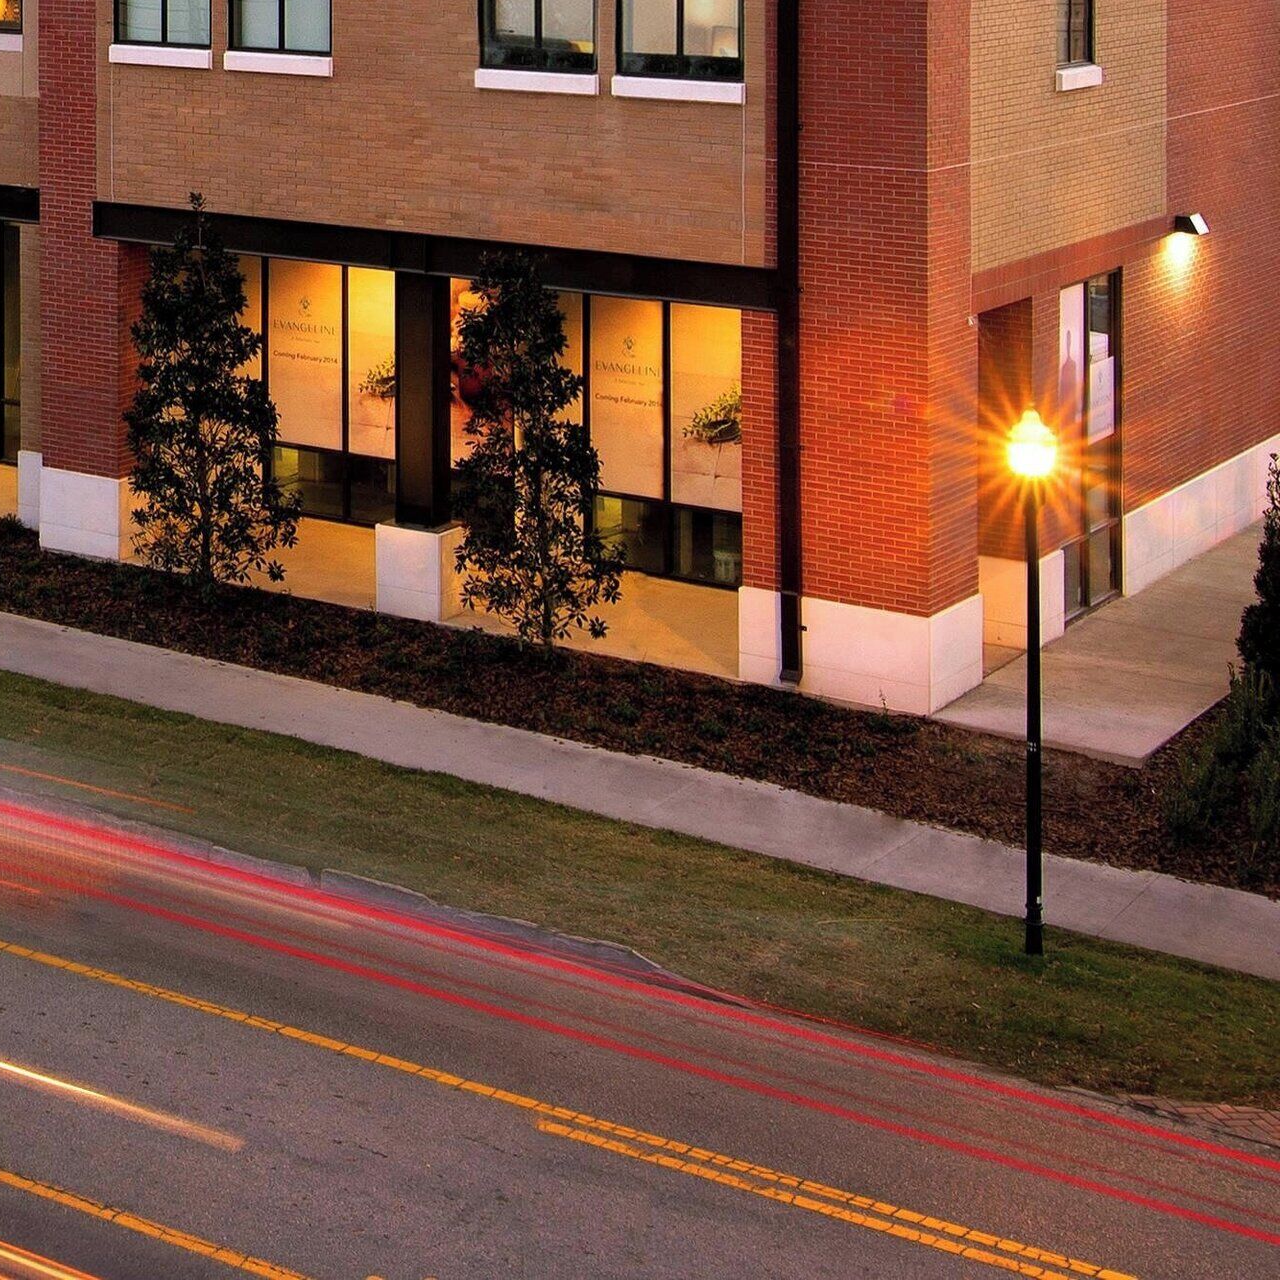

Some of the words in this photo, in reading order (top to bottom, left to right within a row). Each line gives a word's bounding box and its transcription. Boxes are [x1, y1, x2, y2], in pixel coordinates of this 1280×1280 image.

[272, 349, 296, 360] Coming
[296, 353, 322, 363] February
[594, 392, 619, 404] Coming
[620, 396, 647, 407] February
